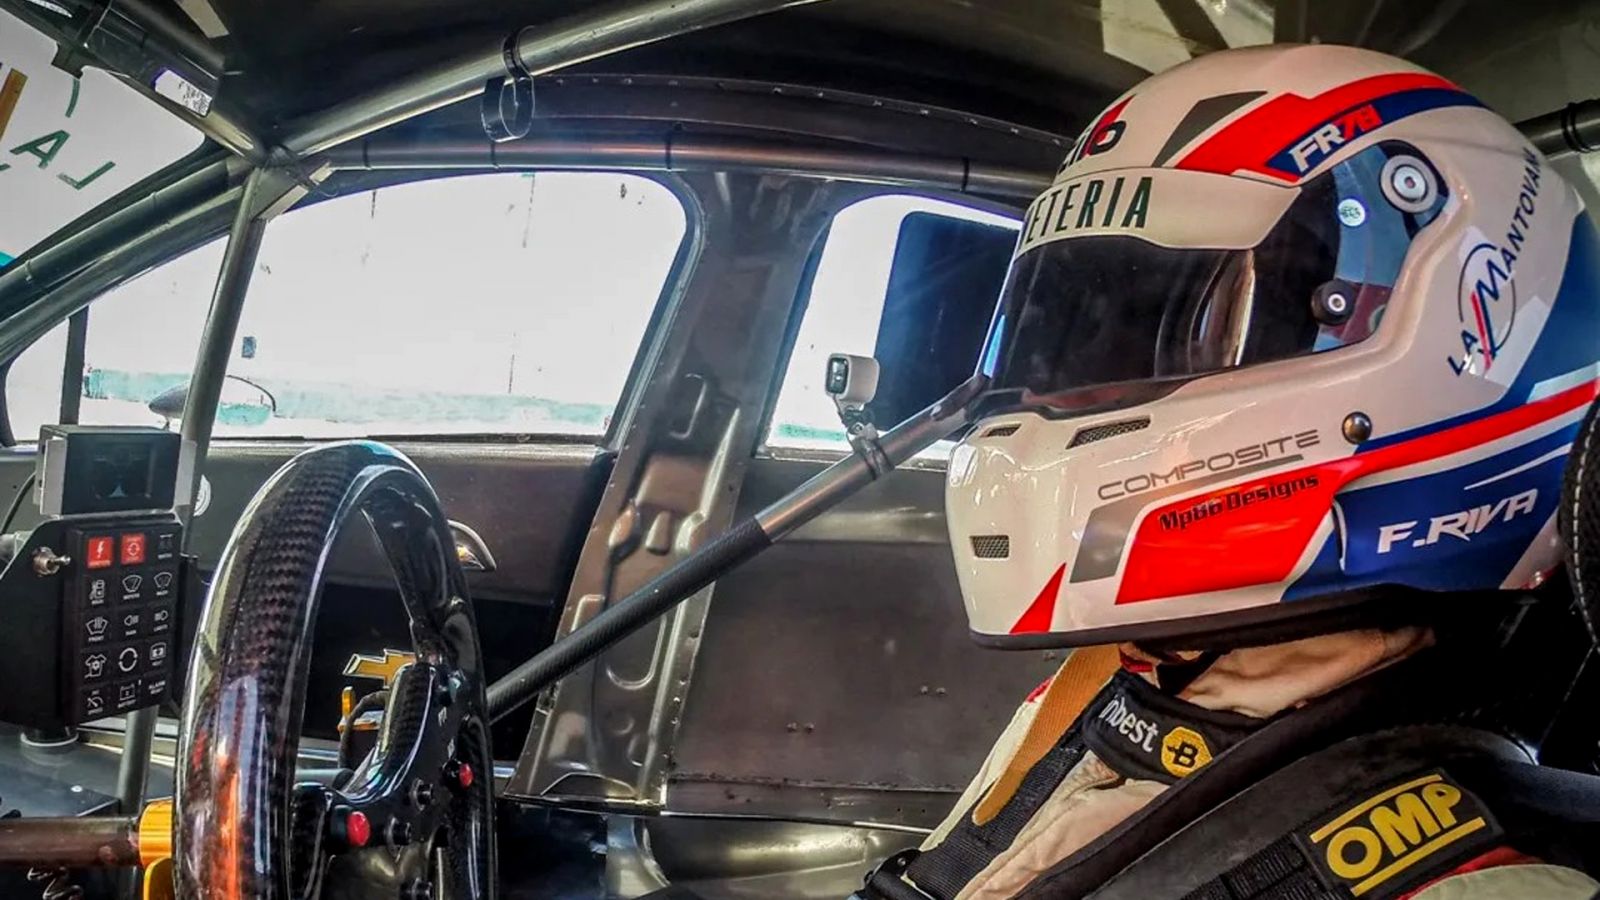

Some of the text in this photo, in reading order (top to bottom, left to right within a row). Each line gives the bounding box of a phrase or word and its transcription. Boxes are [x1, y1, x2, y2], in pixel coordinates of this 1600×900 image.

[1097, 429, 1321, 501] COMPOSITE
[1225, 474, 1320, 512] Designs
[1377, 488, 1539, 554] F.RIVA
[1327, 782, 1462, 879] OMP
